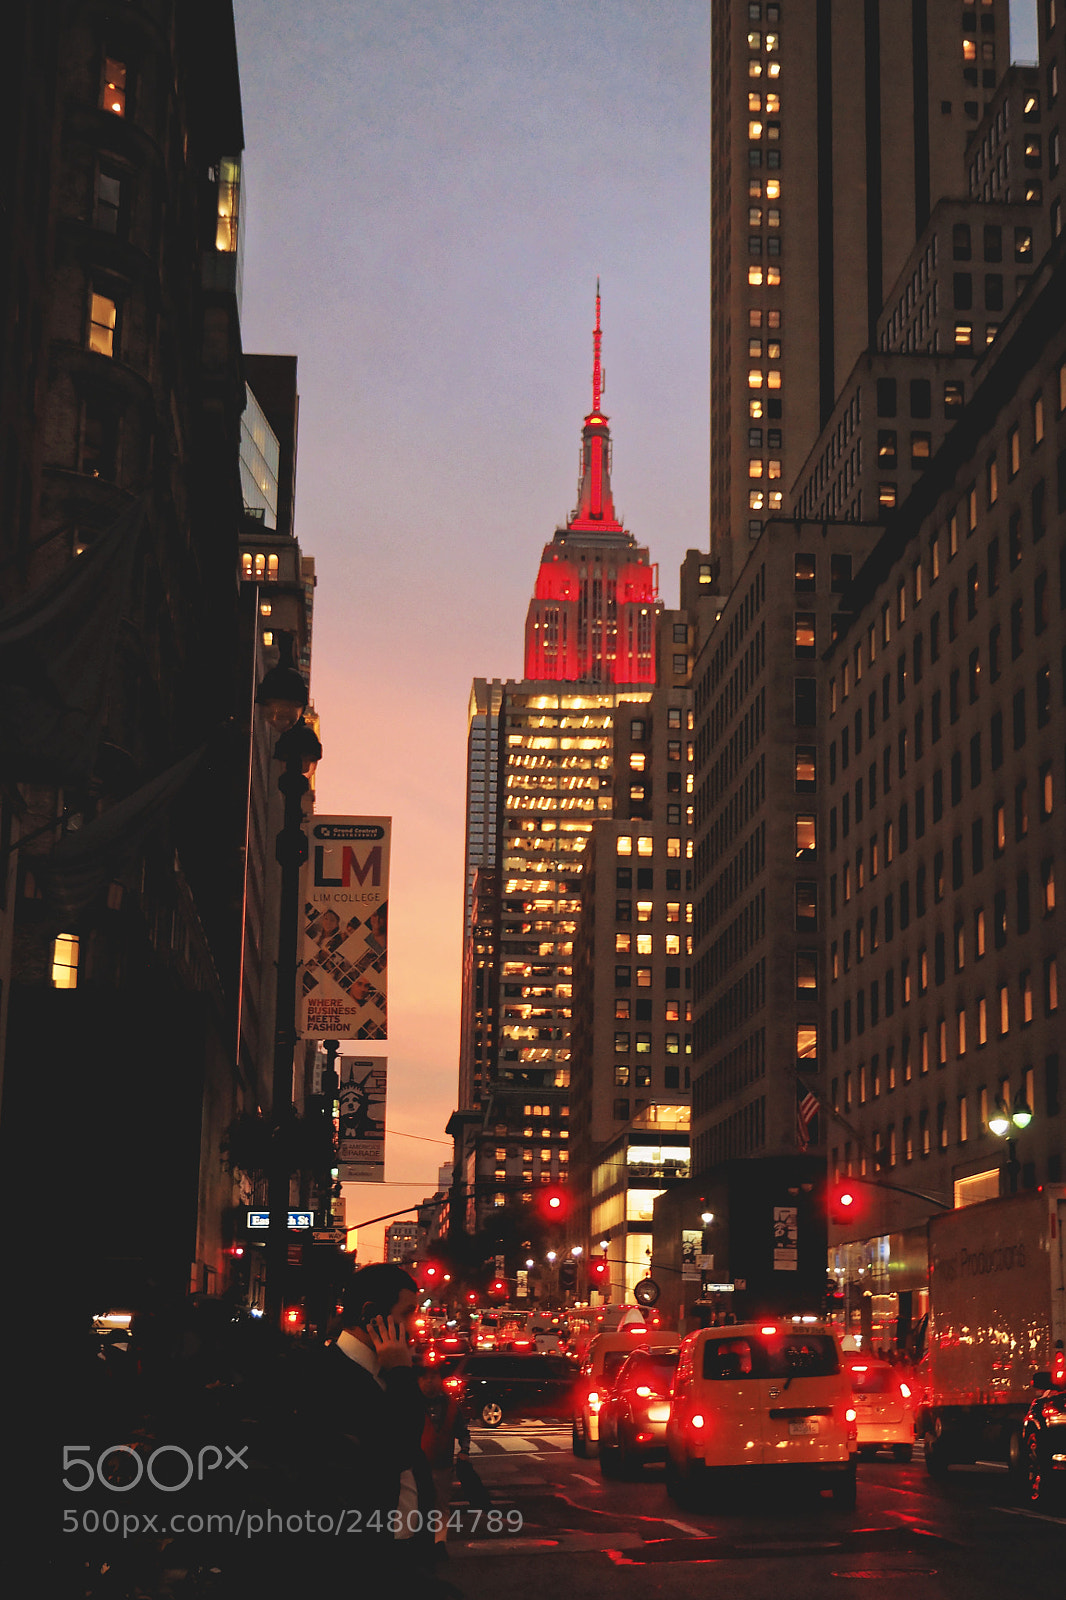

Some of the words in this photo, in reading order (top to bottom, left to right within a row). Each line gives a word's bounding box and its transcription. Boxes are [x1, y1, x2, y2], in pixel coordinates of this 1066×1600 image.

[313, 894, 331, 902] LIM
[333, 893, 380, 902] COLLEGE
[307, 999, 344, 1007] WHERE
[307, 1007, 357, 1015] BUSINESS
[307, 1015, 341, 1023] MEETS
[307, 1023, 351, 1031] FASHION
[252, 1216, 270, 1225] Eas
[297, 1216, 309, 1225] St
